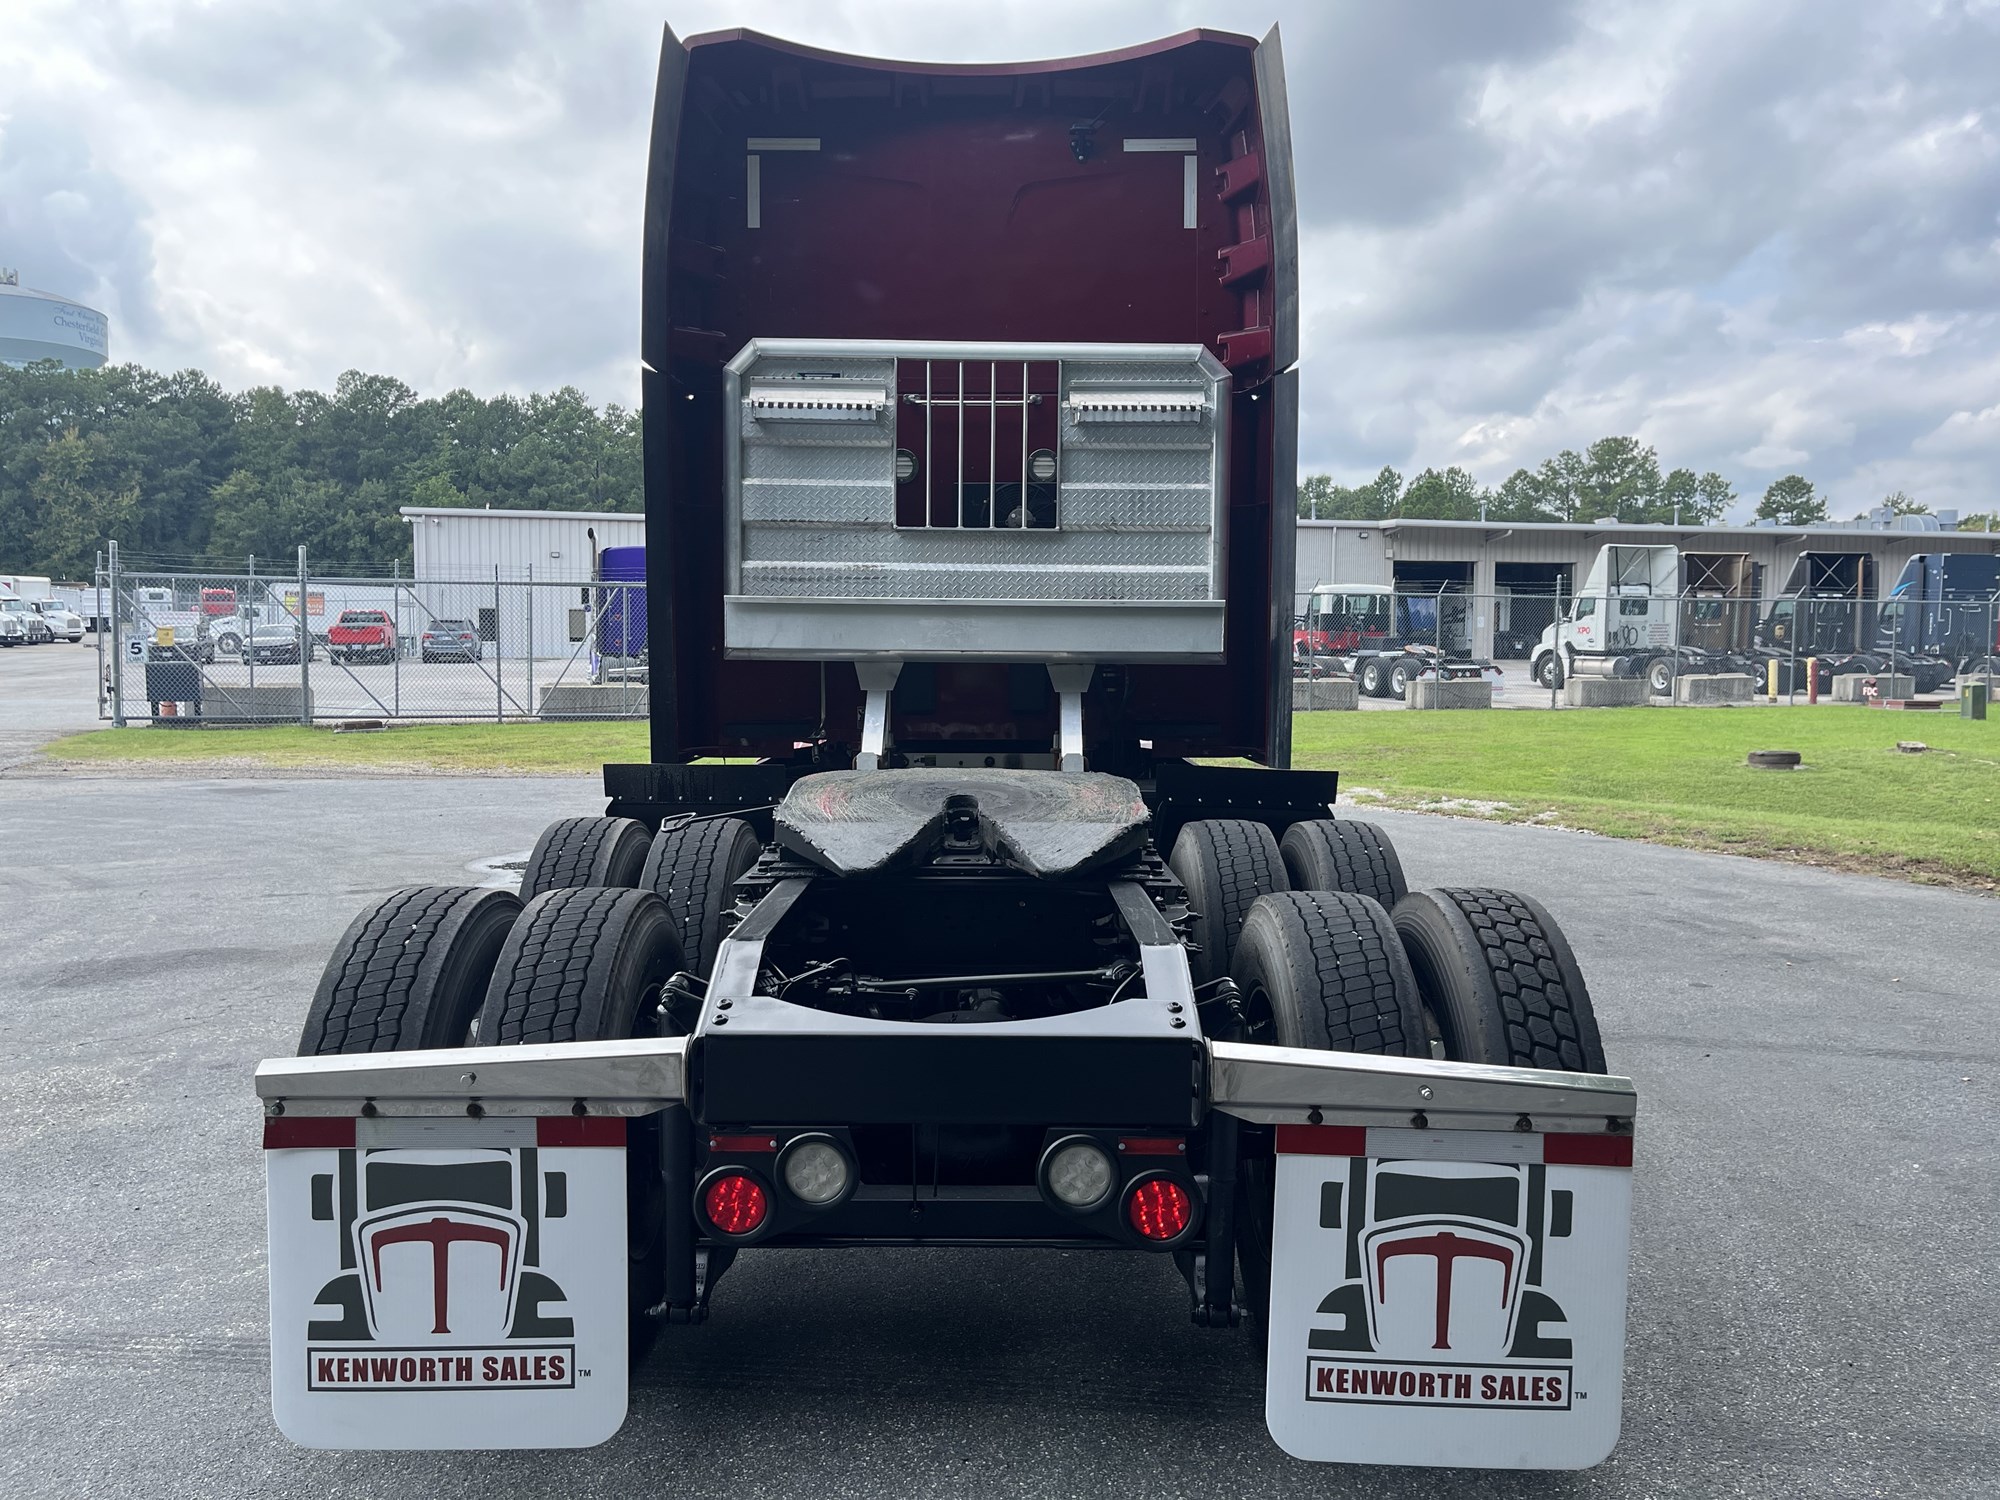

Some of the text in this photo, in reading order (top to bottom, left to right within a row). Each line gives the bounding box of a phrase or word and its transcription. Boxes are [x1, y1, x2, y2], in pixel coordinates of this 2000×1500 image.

[53, 315, 99, 335] Chesterfield
[1577, 626, 1591, 635] XPO
[130, 642, 142, 655] 5
[128, 655, 144, 663] LIMIT
[1862, 686, 1878, 696] FDC
[318, 1356, 473, 1383] KENWORTH
[482, 1355, 566, 1381] SALES
[1316, 1367, 1472, 1399] KENWORTH
[1481, 1374, 1563, 1402] SALES
